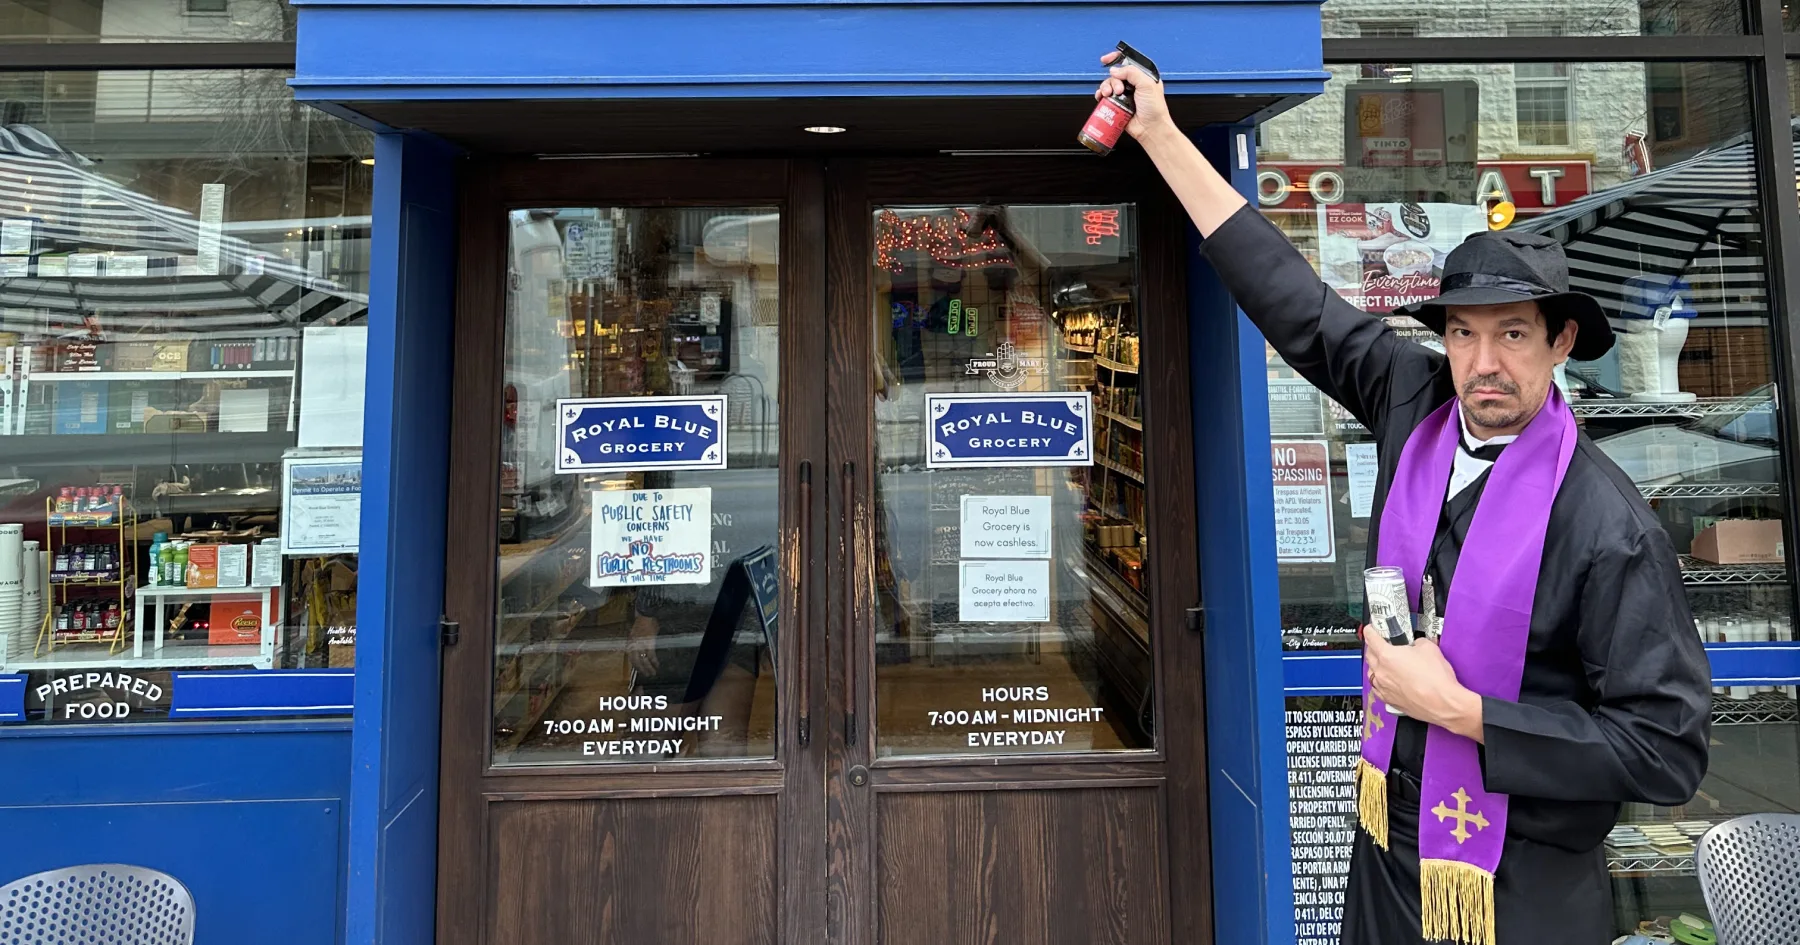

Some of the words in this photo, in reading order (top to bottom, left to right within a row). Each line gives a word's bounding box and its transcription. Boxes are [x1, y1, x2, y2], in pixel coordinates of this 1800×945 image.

[1373, 140, 1407, 148] TINTO
[1362, 269, 1440, 294] Everytime
[1342, 295, 1382, 307] RFECT
[158, 352, 181, 360] OCB
[572, 416, 645, 443] ROYAL
[654, 414, 712, 439] BLUE
[940, 412, 1012, 438] ROYAL
[1021, 410, 1078, 436] BLUE
[600, 441, 686, 454] GROCERY
[968, 437, 1052, 449] GROCERY
[1274, 447, 1296, 466] NO
[1272, 468, 1322, 482] SPASSING
[321, 486, 344, 494] Operate
[632, 492, 648, 502] DUE
[602, 504, 643, 524] PUBLIC
[652, 504, 693, 522] SAFETY
[982, 506, 1008, 518] Royal
[1010, 506, 1030, 515] Blue
[626, 522, 670, 533] CONCERNS
[982, 522, 1020, 534] Grocery
[1023, 522, 1030, 531] is
[1286, 529, 1310, 537] Trespass
[974, 539, 994, 547] now
[996, 537, 1038, 548] cashless.
[631, 543, 650, 556] NO
[600, 556, 634, 574] PUBLIC
[642, 556, 701, 574] RESTROOMS
[632, 574, 645, 582] THIS
[648, 574, 666, 582] TIME
[985, 574, 1006, 584] Royal
[1007, 574, 1024, 582] Blue
[972, 586, 1002, 596] Grocery
[1003, 586, 1026, 594] ahora
[974, 600, 1001, 609] acepta
[1002, 599, 1036, 608] efectivo.
[36, 672, 163, 702] PREPARED
[982, 686, 1049, 702] HOURS
[600, 695, 668, 711] HOURS
[65, 702, 130, 719] FOOD
[1013, 707, 1104, 724] MIDNIGHT
[1293, 711, 1302, 724] TO
[1304, 710, 1334, 724] SECTION
[1335, 710, 1358, 724] 30.07,
[630, 715, 722, 733] MIDNIGHT
[1286, 726, 1312, 738] ESPASS
[1312, 726, 1322, 738] BY
[1324, 726, 1352, 738] LICENSE
[1354, 725, 1364, 738] HO
[968, 730, 1066, 747] EVERYDAY
[583, 738, 684, 756] EVERYDAY
[1286, 740, 1314, 754] OPENLY
[1316, 740, 1347, 753] CARRIED
[1291, 756, 1320, 768] LICENSE
[1321, 756, 1347, 768] UNDER
[1288, 771, 1298, 784] ER
[1298, 772, 1315, 785] 411,
[1316, 770, 1356, 783] GOVERNME
[1290, 786, 1296, 798] N
[1296, 786, 1334, 798] LICENSING
[1290, 801, 1298, 814] IS
[1298, 801, 1336, 814] PROPERTY
[1337, 800, 1357, 813] WITH
[1290, 816, 1316, 828] ARRIED
[1317, 816, 1347, 828] OPENLY.
[1324, 831, 1346, 844] 30.07
[1291, 846, 1323, 859] RASPASO
[1324, 846, 1334, 858] DE
[1335, 846, 1353, 858] PERS
[1292, 862, 1302, 874] DE
[1302, 862, 1332, 874] PORTAR
[1333, 861, 1350, 874] ARM
[1322, 876, 1339, 889] UNA
[1318, 892, 1334, 904] SUB
[1334, 892, 1345, 904] CH
[1294, 908, 1300, 920] O
[1302, 907, 1318, 922] 411,
[1320, 907, 1334, 920] DEL
[1334, 906, 1344, 920] CO
[1300, 922, 1316, 938] (LEY
[1316, 922, 1327, 936] DE
